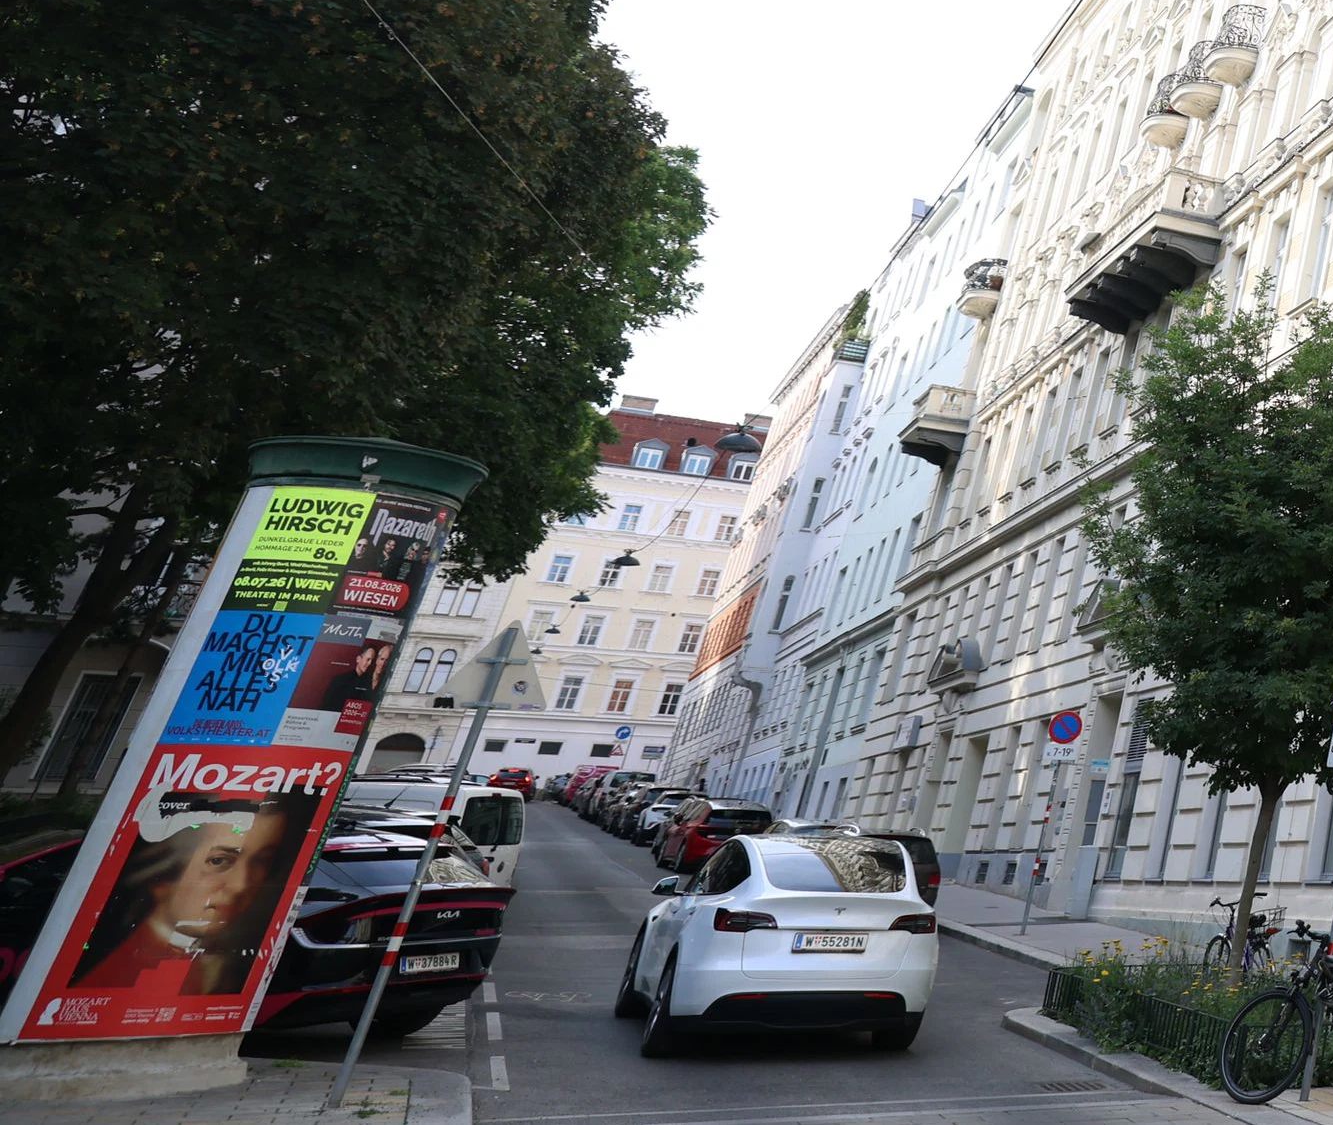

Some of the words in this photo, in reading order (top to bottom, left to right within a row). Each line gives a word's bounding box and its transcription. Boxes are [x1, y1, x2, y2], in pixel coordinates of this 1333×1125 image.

[269, 498, 365, 519] LUDWIG
[264, 516, 354, 535] HIRSCH
[369, 508, 437, 547] Nazareth
[258, 536, 314, 545] DUNKELGRAUE
[315, 538, 344, 547] LIEDER
[313, 547, 338, 561] 80.
[234, 576, 286, 588] 08.07.26
[295, 578, 335, 592] WIEN
[348, 578, 402, 593] 21.08.2026
[234, 590, 277, 599] THEATER
[278, 591, 291, 600] IM
[292, 593, 321, 602] PARK
[343, 589, 399, 607] WIESEN
[242, 614, 285, 634] DU
[203, 632, 314, 656] MACHST
[220, 651, 273, 673] MIR
[195, 670, 278, 693] ALLES
[197, 689, 263, 712] NAH
[167, 726, 272, 738] VOLKSTHEATER.AT
[148, 753, 343, 796] Mozart?
[436, 910, 460, 919] KIA
[805, 936, 814, 947] W
[821, 936, 865, 947] 55281N
[407, 958, 416, 969] W
[63, 1004, 89, 1014] HAUS
[66, 997, 112, 1006] MOZART
[58, 1011, 98, 1022] VIENNA
